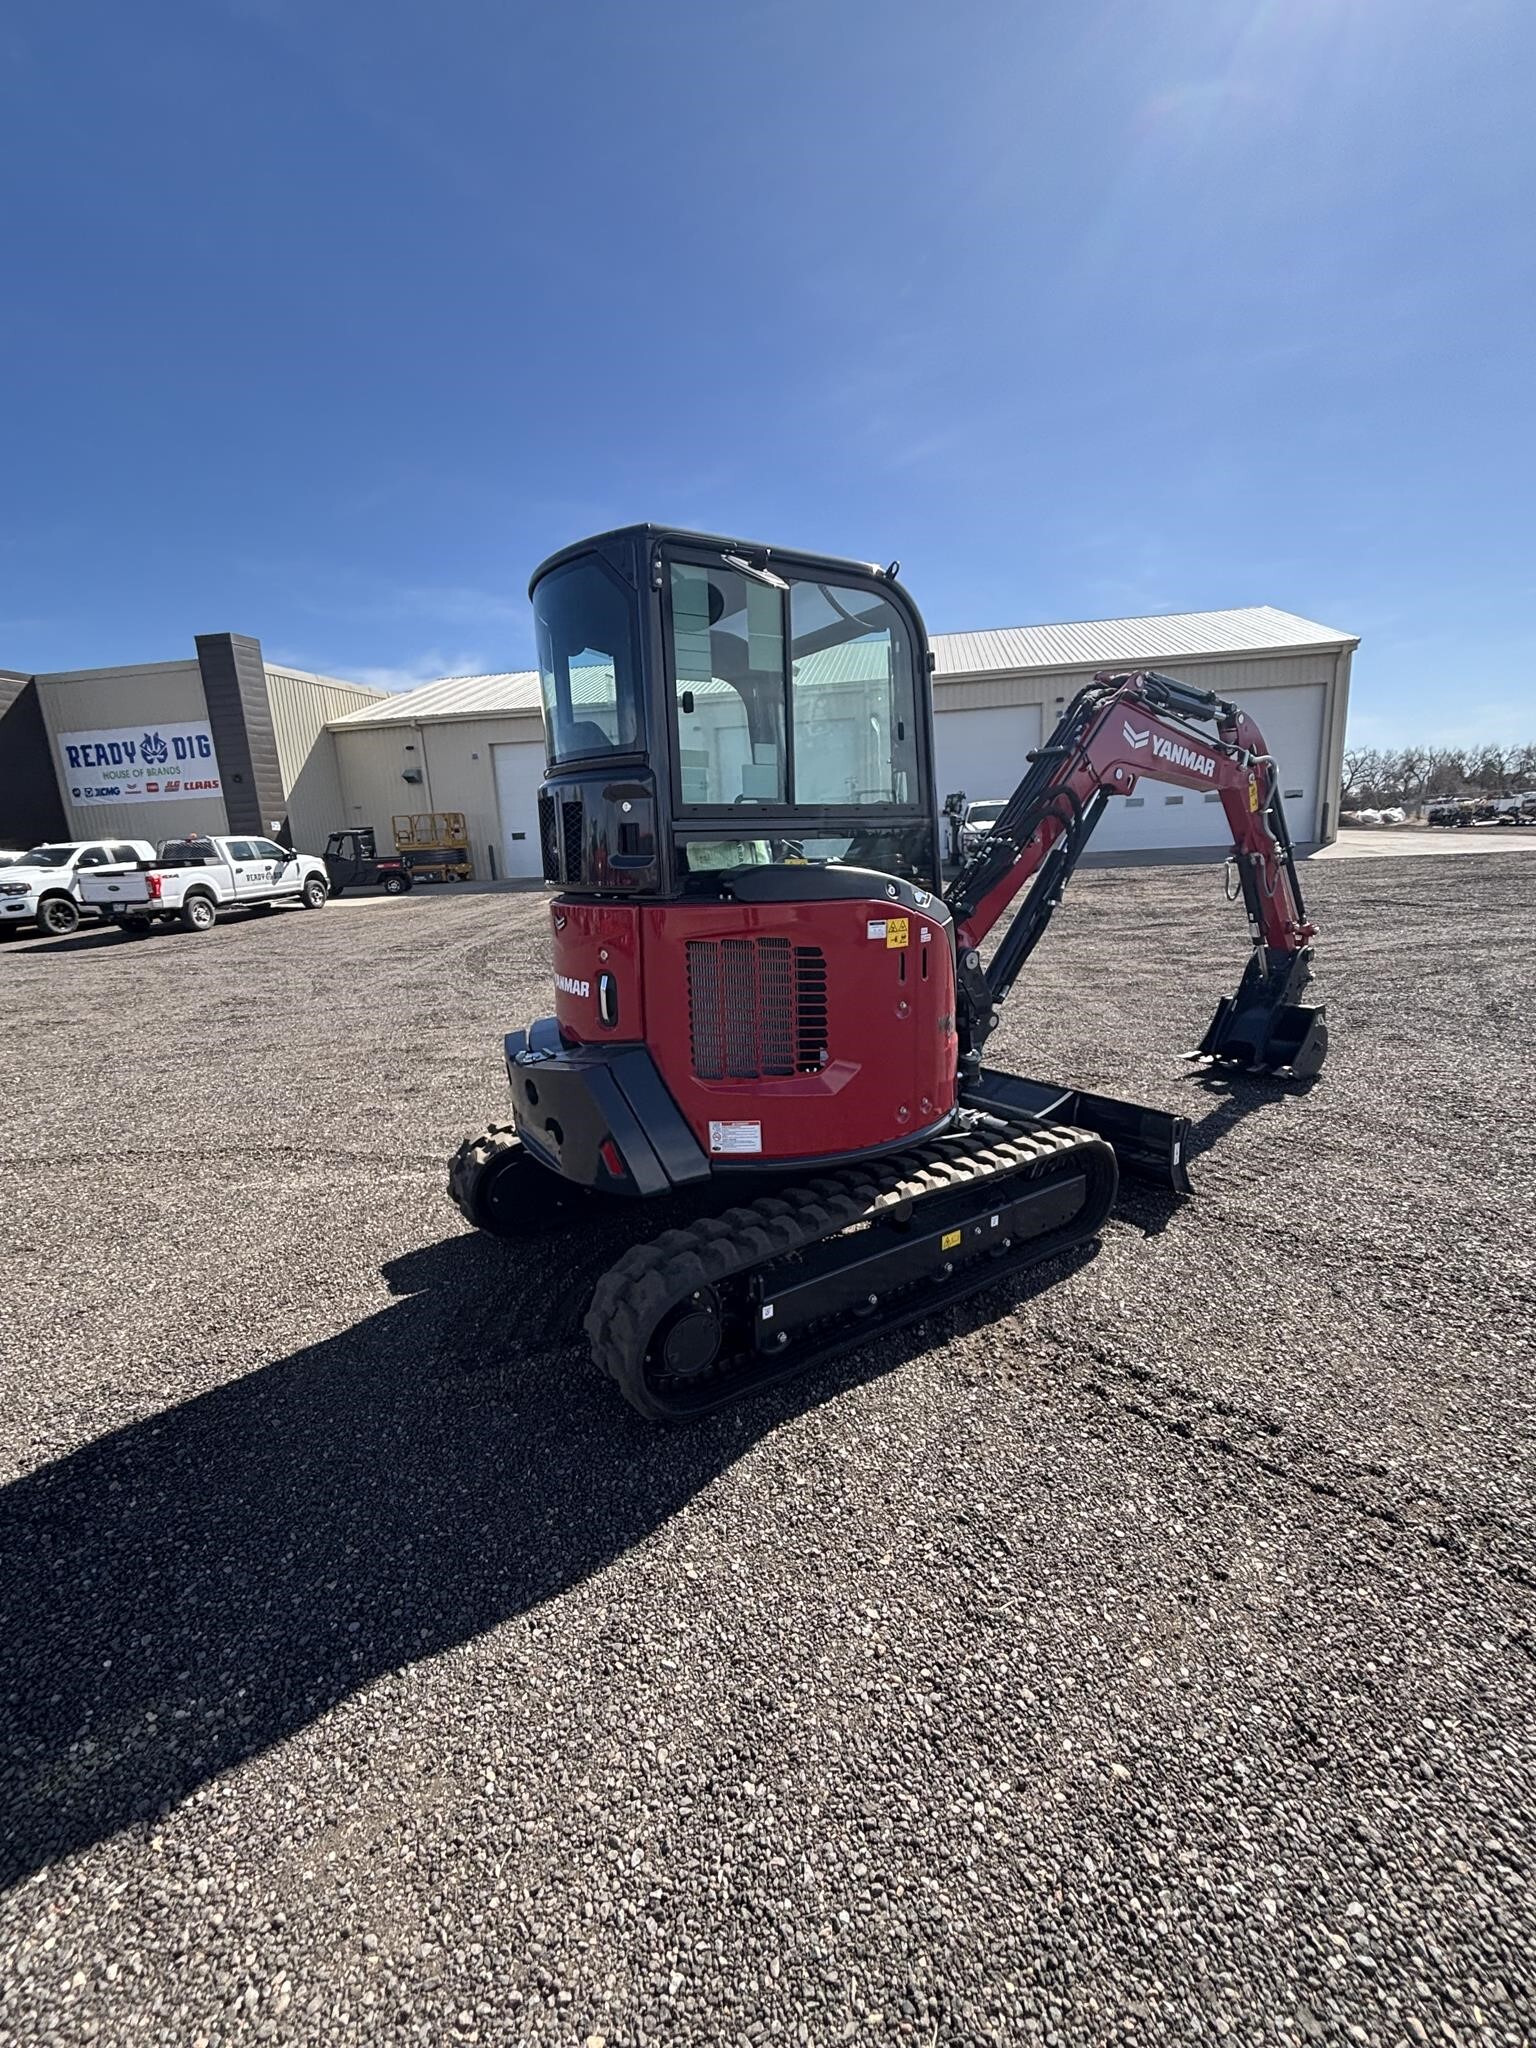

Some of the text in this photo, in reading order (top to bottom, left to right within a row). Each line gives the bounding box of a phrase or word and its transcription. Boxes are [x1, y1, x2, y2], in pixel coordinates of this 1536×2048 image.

[65, 734, 212, 768] READY DIG
[1152, 734, 1216, 778] YANMAR
[103, 766, 181, 780] HOUSE OF BRANDS
[184, 780, 219, 790] CLAAS
